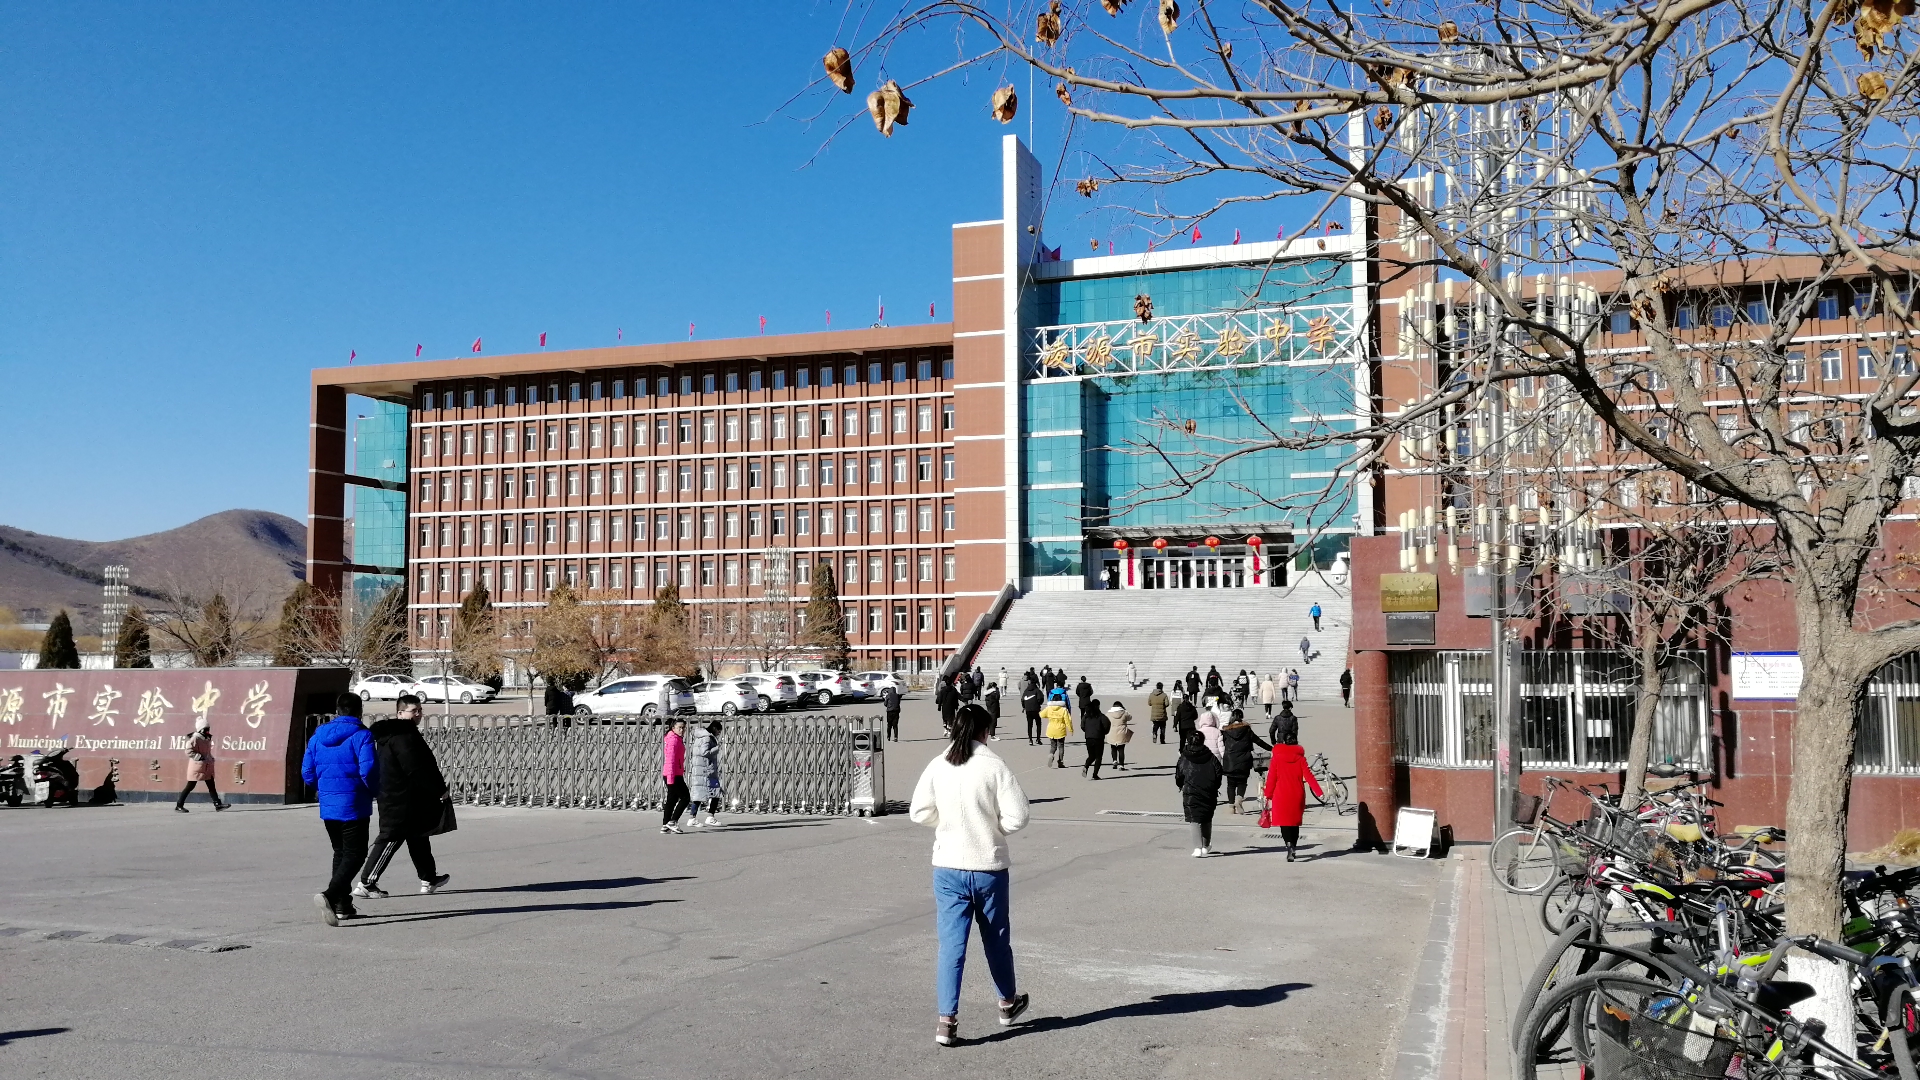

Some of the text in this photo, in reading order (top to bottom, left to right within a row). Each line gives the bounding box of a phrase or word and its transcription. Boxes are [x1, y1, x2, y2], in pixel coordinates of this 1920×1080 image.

[1041, 315, 1337, 370] 凌源市实验中学
[75, 734, 162, 752] Experimental
[222, 735, 267, 751] School
